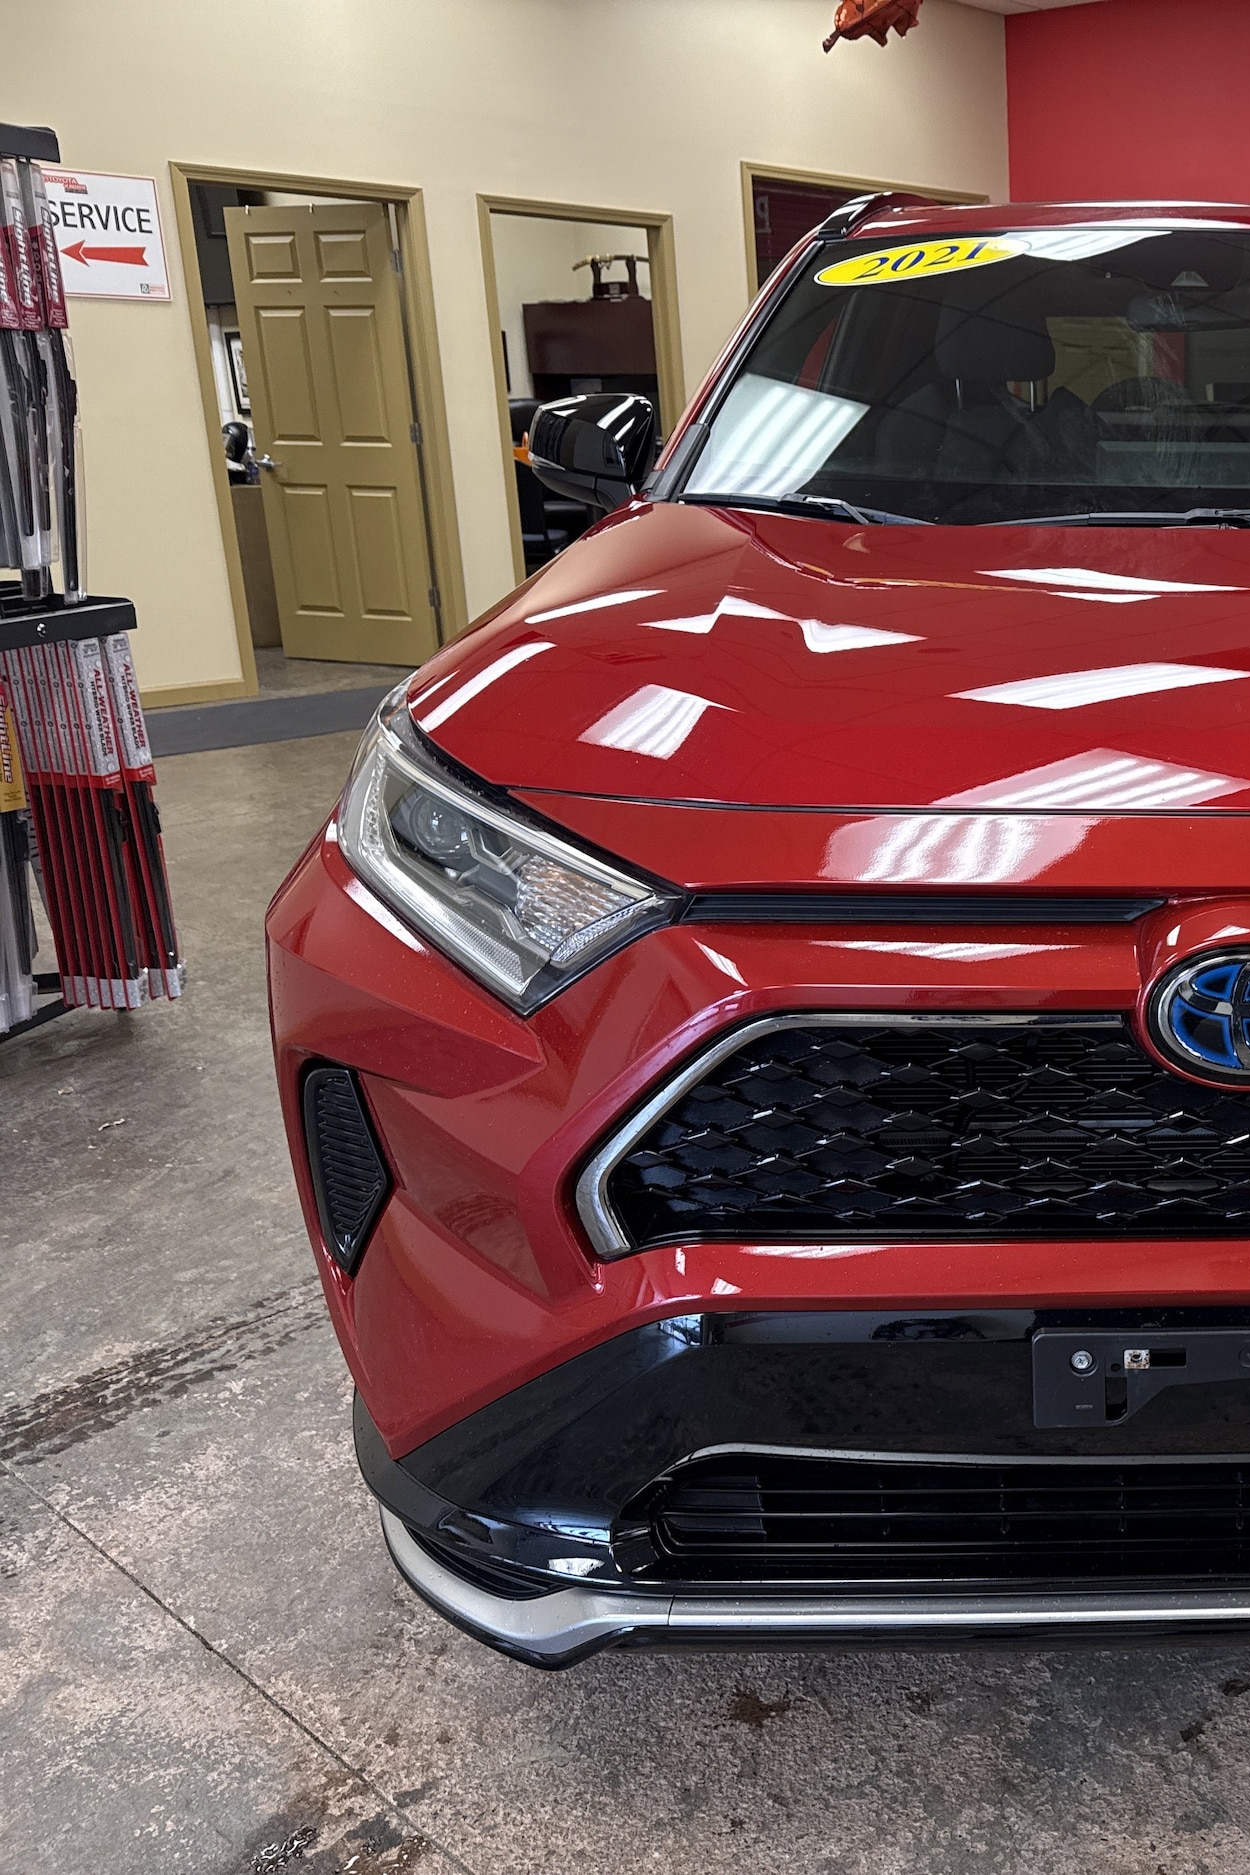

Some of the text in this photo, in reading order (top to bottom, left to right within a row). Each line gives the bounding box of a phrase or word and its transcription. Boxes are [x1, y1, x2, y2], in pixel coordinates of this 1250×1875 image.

[48, 200, 153, 235] SERVICE
[852, 240, 990, 281] 2021
[93, 668, 115, 755] ALL-WEATHER
[123, 663, 147, 749] ALL-WEATHER
